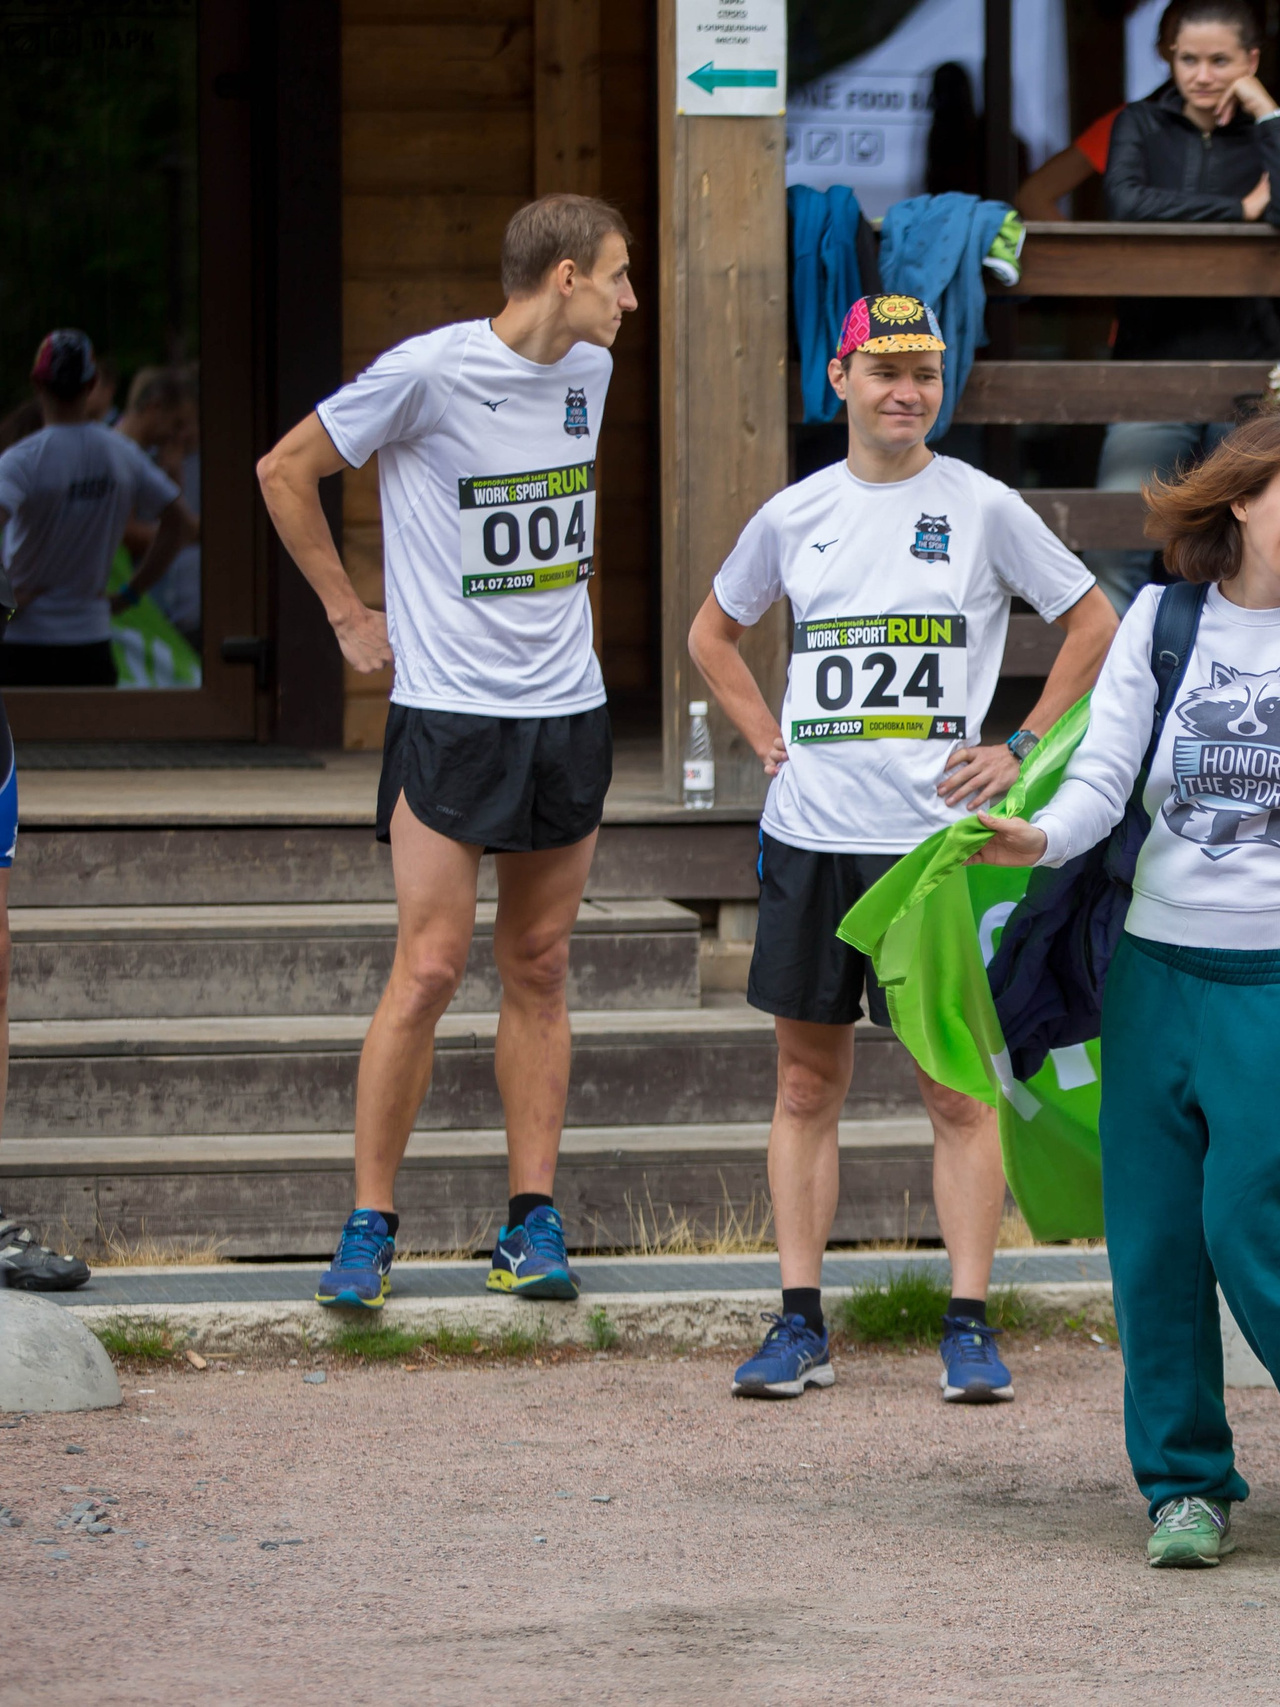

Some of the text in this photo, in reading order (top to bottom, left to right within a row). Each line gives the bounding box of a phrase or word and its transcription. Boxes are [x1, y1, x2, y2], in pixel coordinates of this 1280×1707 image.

[474, 466, 588, 505] WORK&SPORT RUN
[483, 500, 587, 566] 004
[470, 574, 534, 592] 14.07.2019
[807, 618, 952, 649] WORK&SPORT RUN
[816, 652, 944, 711] 024
[798, 721, 862, 738] 14.07.2019
[869, 721, 924, 732] СОСНОВКА ПАРК
[1184, 776, 1225, 796] THE
